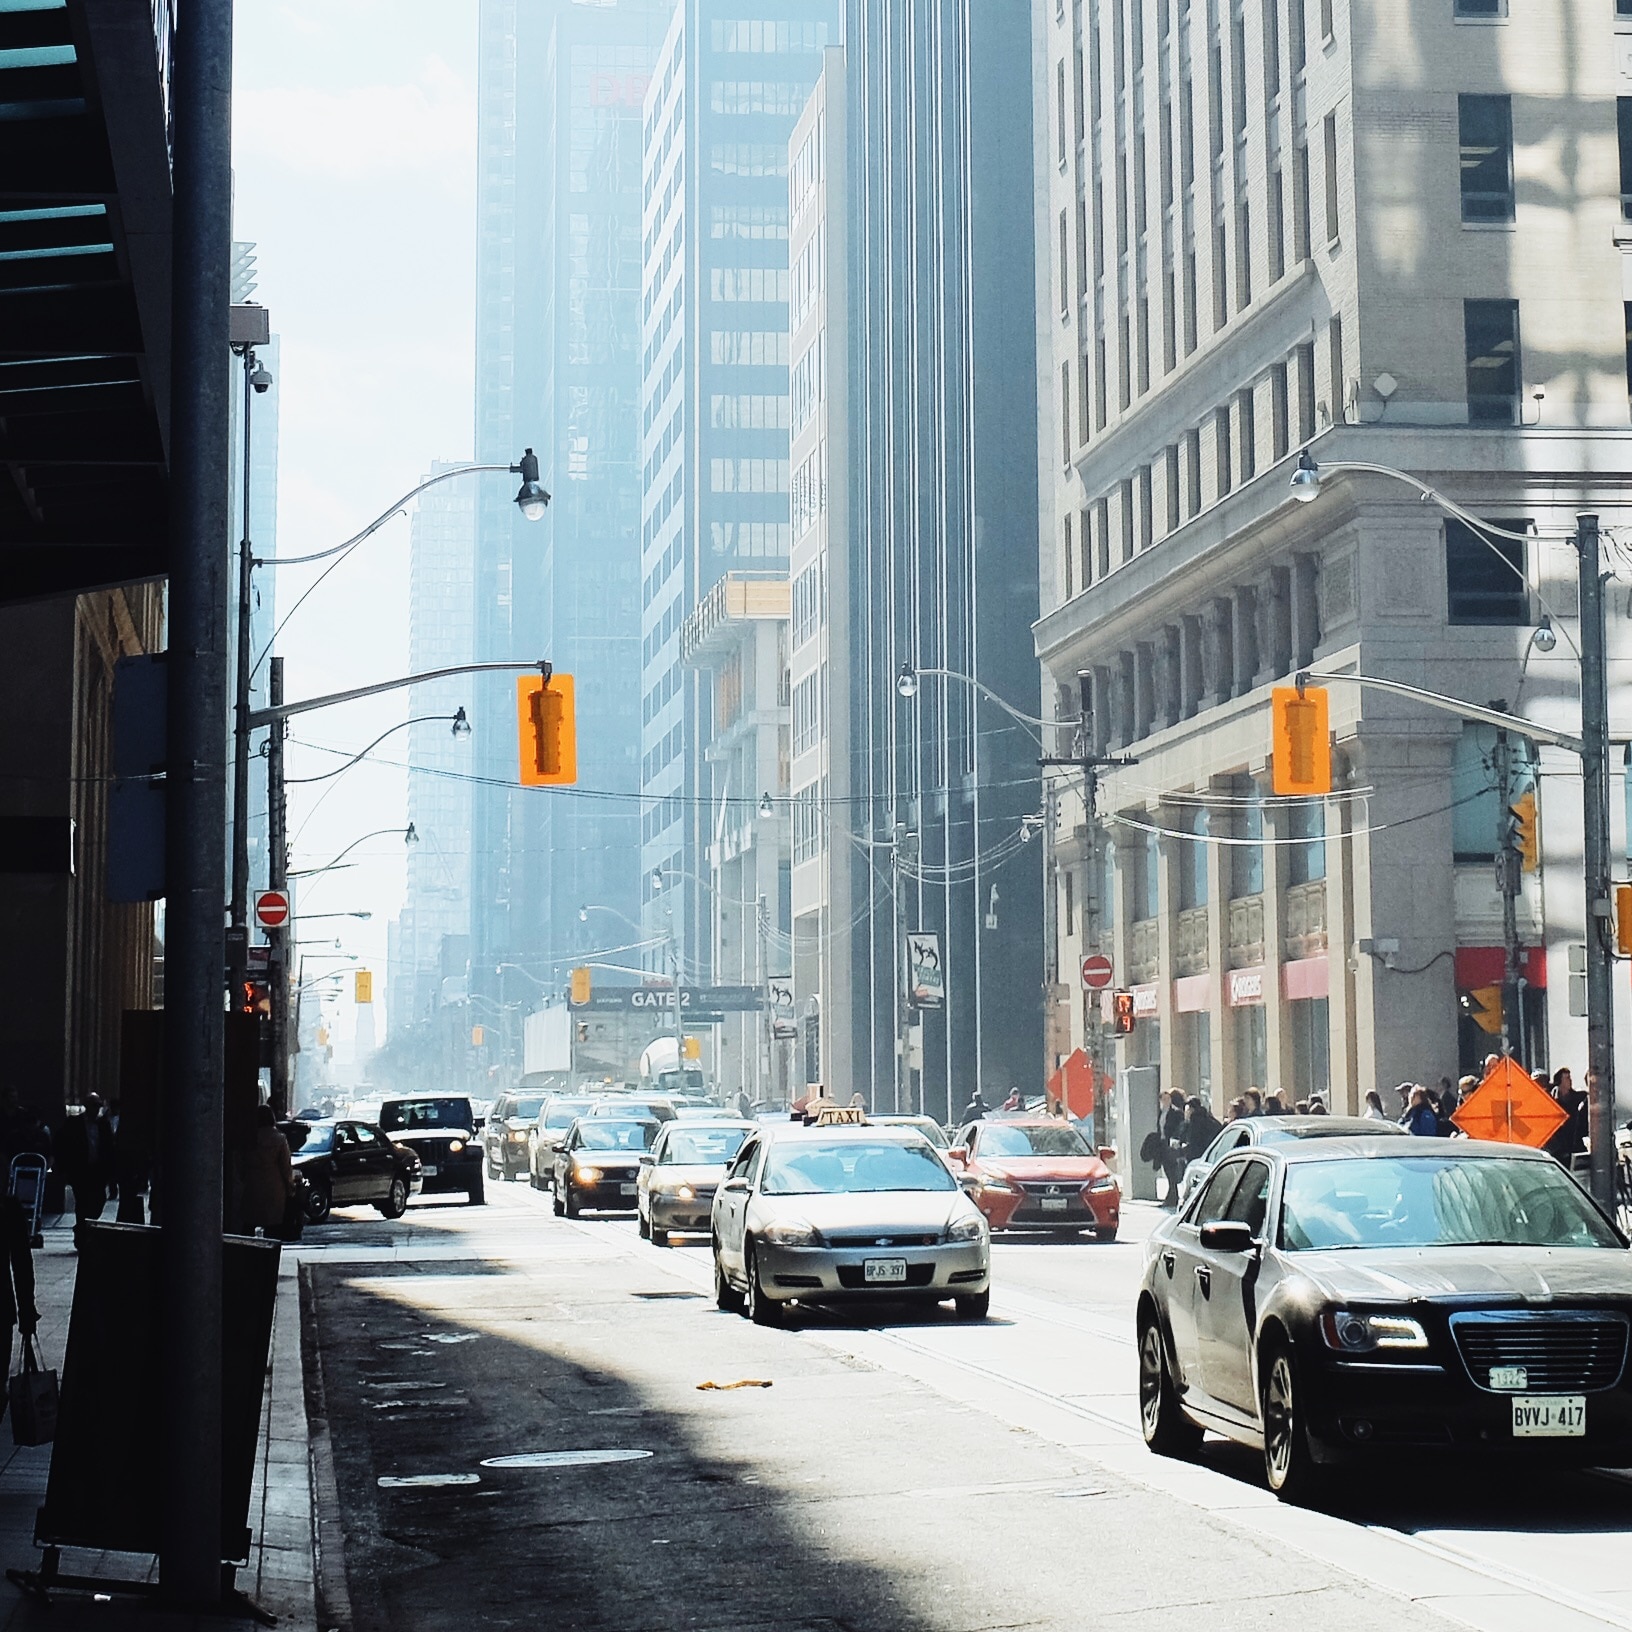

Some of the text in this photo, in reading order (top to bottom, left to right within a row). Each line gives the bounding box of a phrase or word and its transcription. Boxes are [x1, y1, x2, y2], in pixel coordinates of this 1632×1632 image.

[631, 991, 676, 1007] GATE
[681, 992, 690, 1006] 2
[828, 1111, 860, 1123] TAXI
[1514, 1406, 1584, 1426] BVVJ 417
